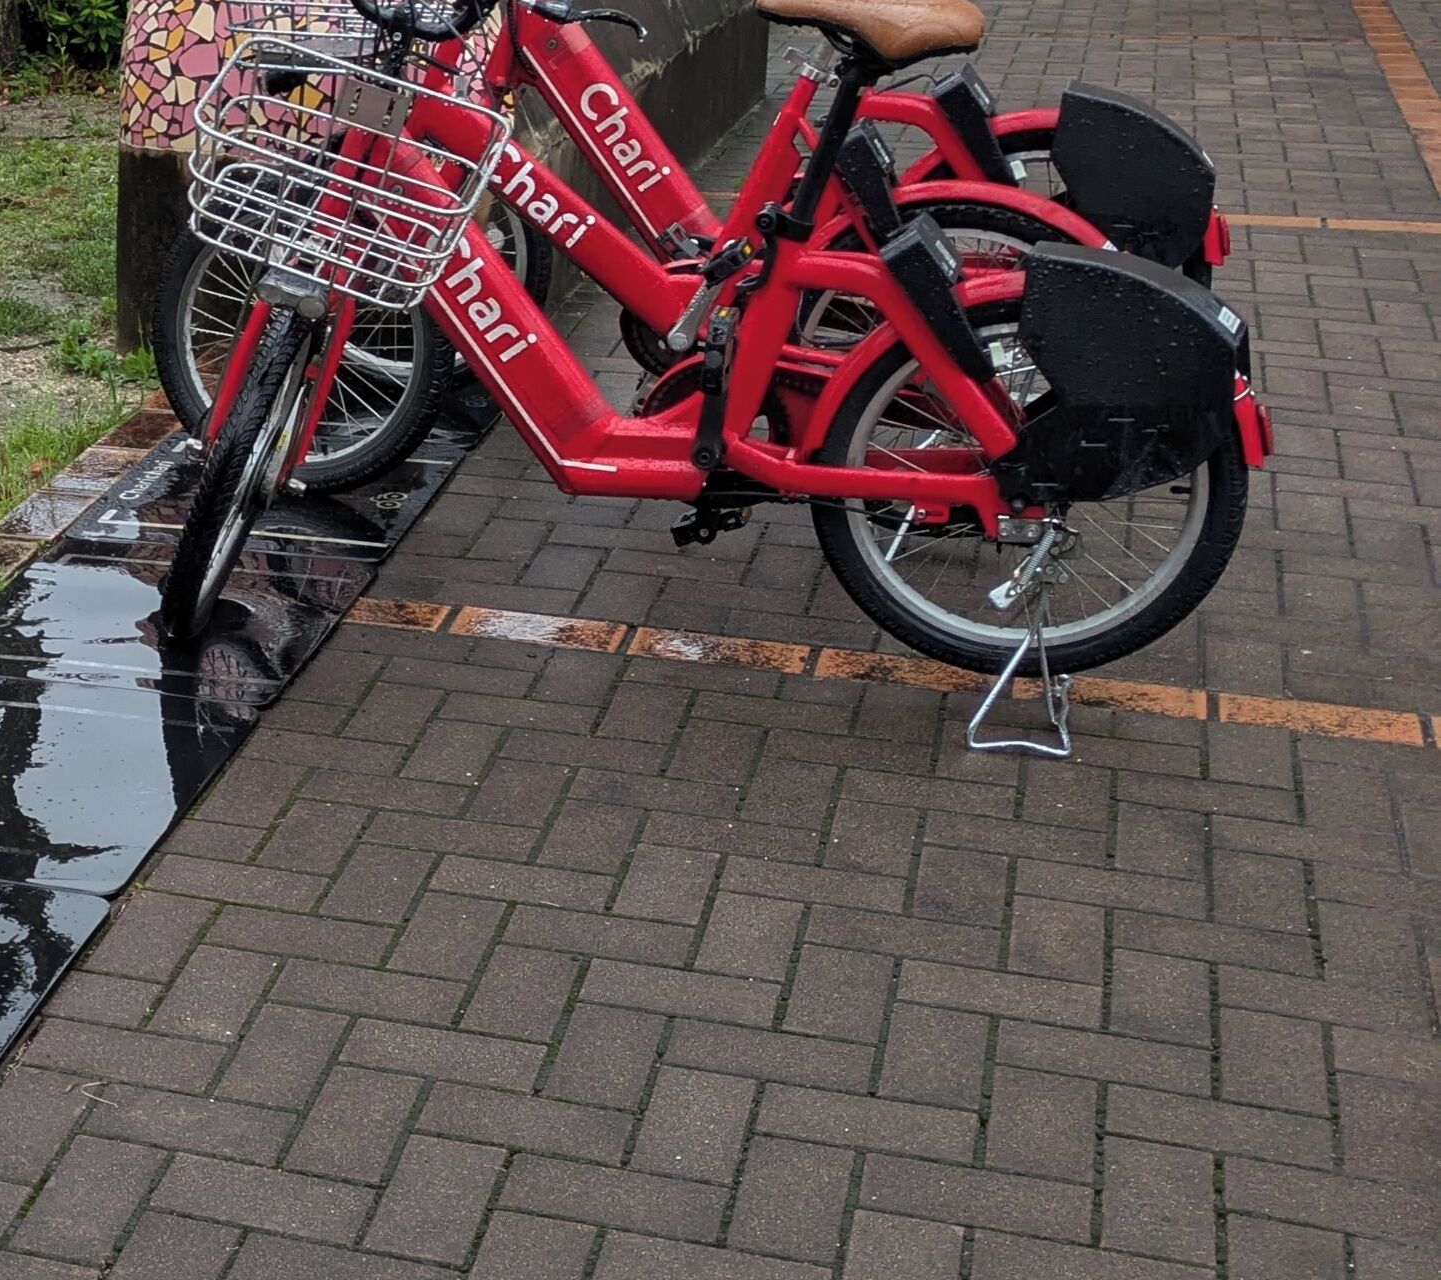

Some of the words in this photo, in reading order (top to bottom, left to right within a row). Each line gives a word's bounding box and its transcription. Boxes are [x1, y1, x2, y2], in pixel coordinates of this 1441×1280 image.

[580, 82, 671, 193] Chari
[485, 141, 596, 249] Chari
[119, 460, 175, 500] Charichari
